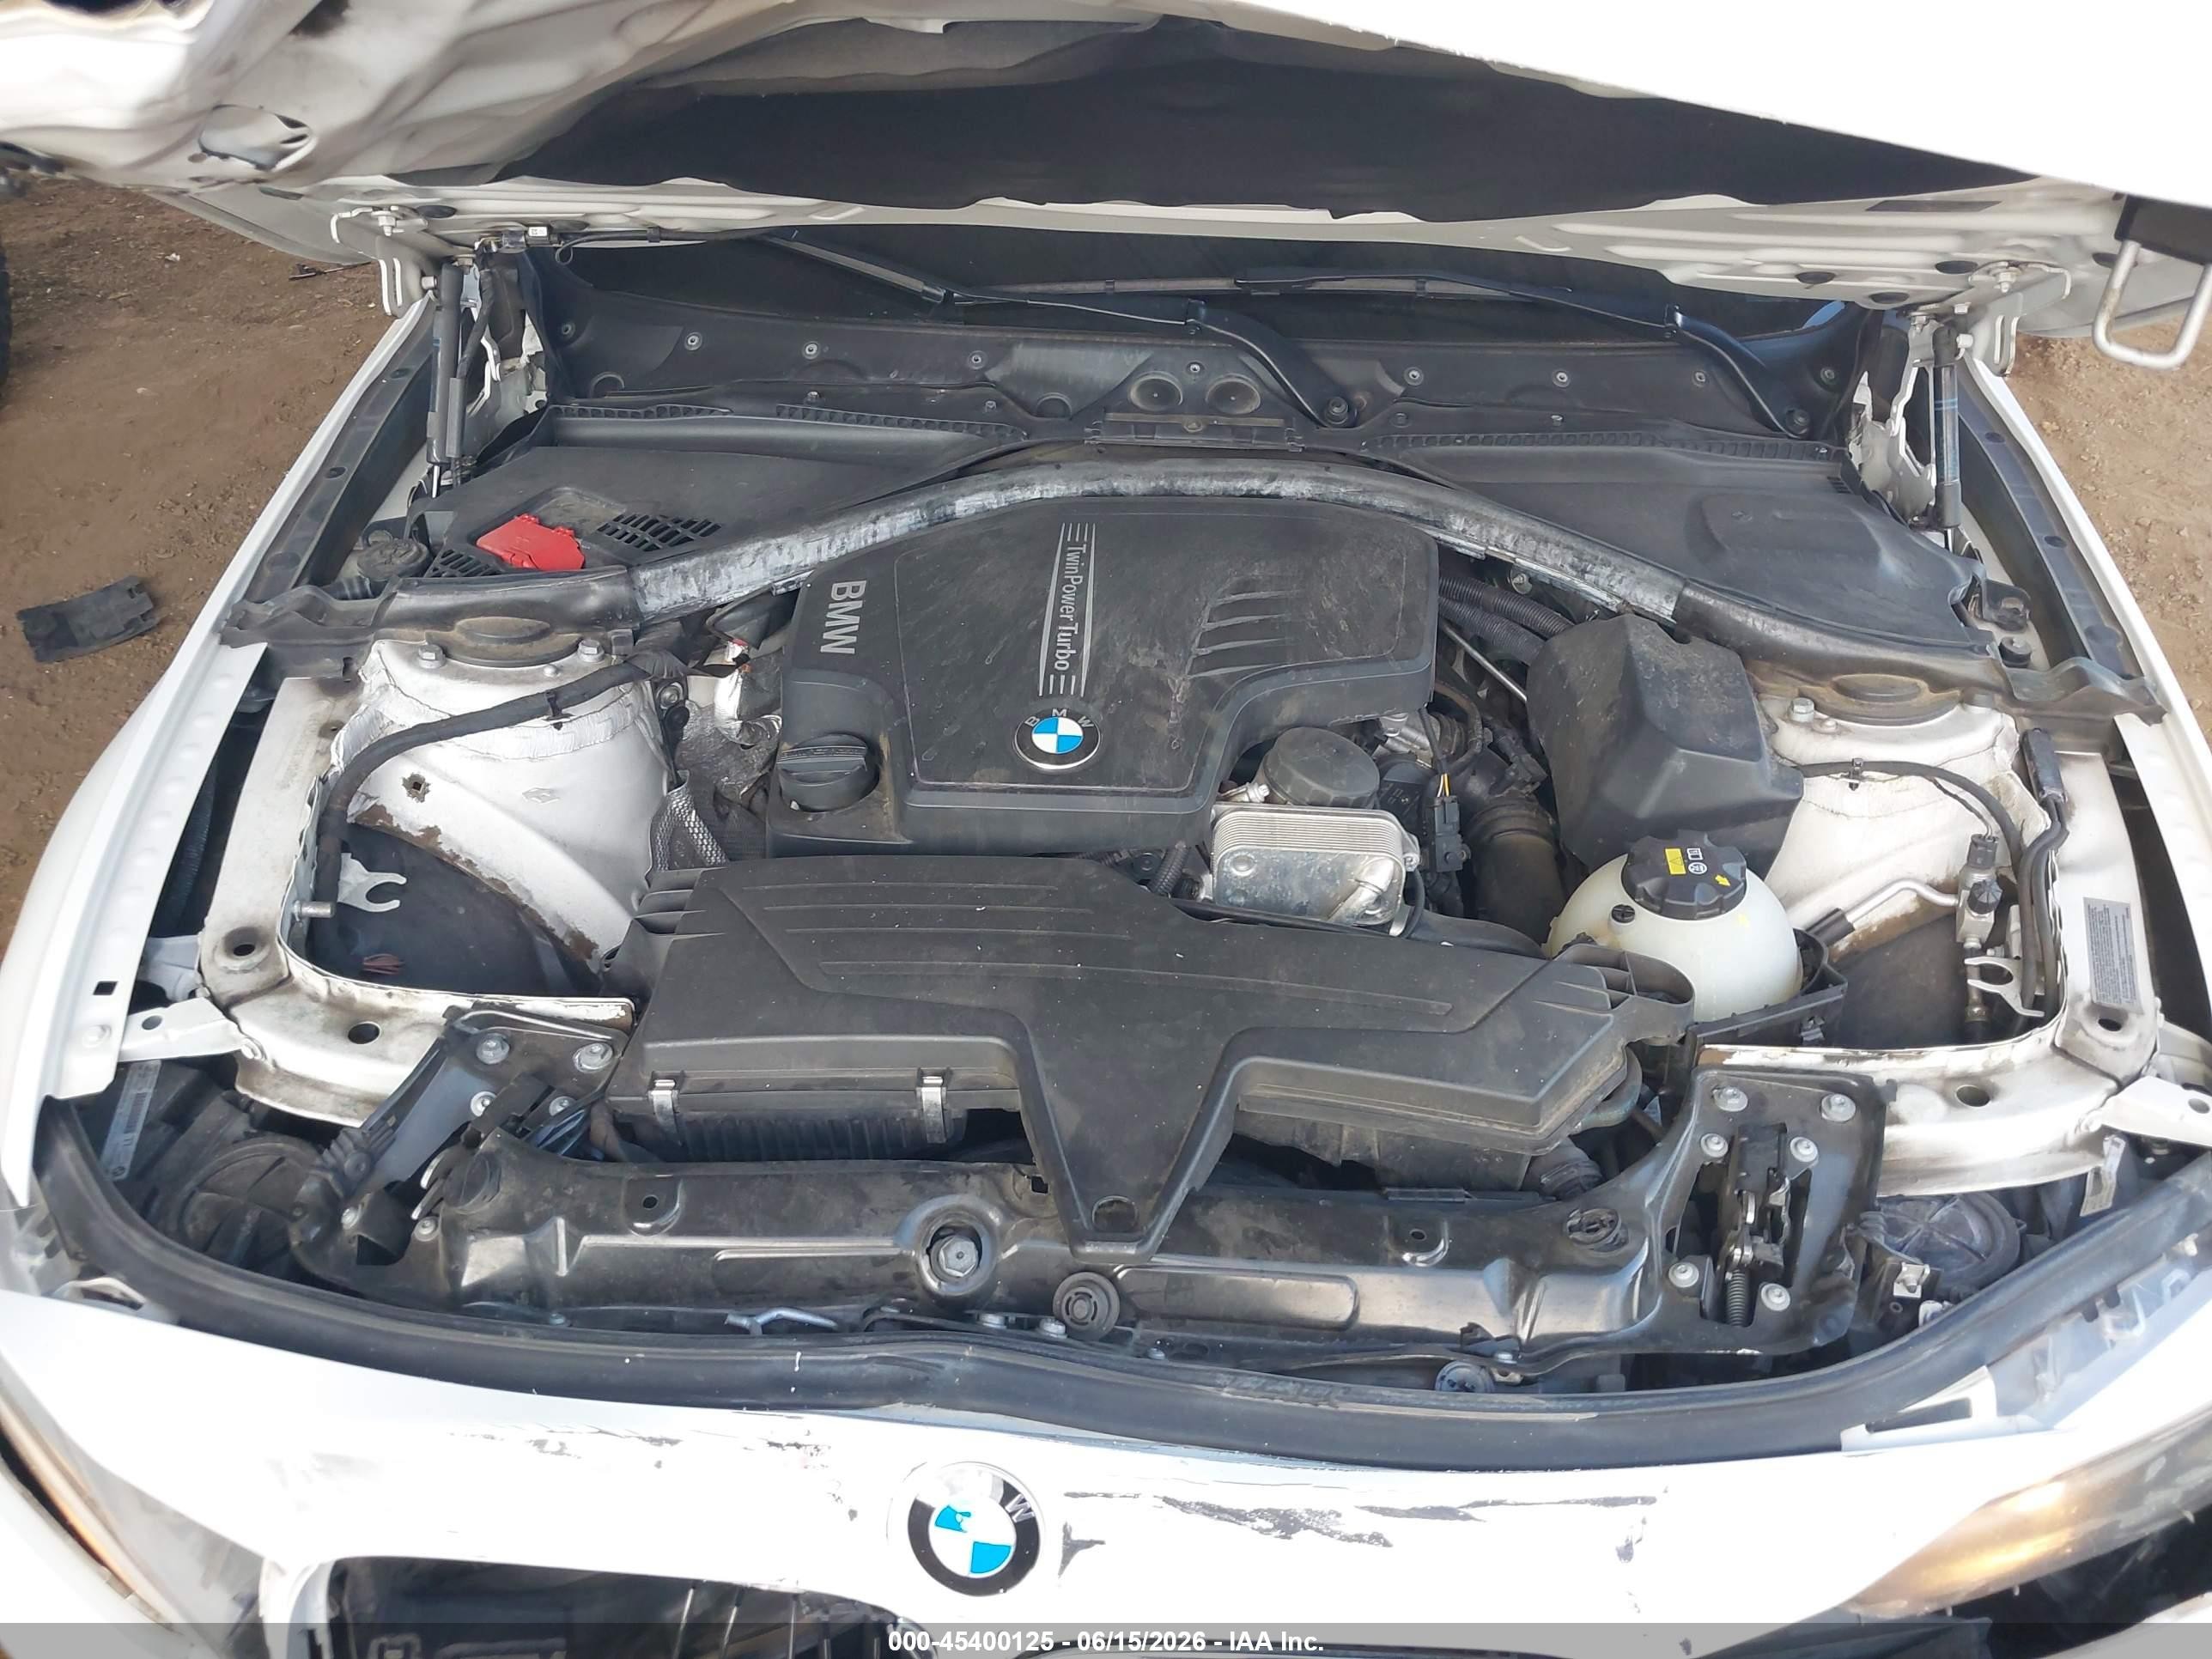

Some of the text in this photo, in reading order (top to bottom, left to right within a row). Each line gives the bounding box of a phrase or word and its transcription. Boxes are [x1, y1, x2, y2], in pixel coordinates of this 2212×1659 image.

[820, 580, 867, 654] BMW
[1054, 544, 1086, 672] TwinPower Turbo
[1024, 708, 1094, 727] BMW
